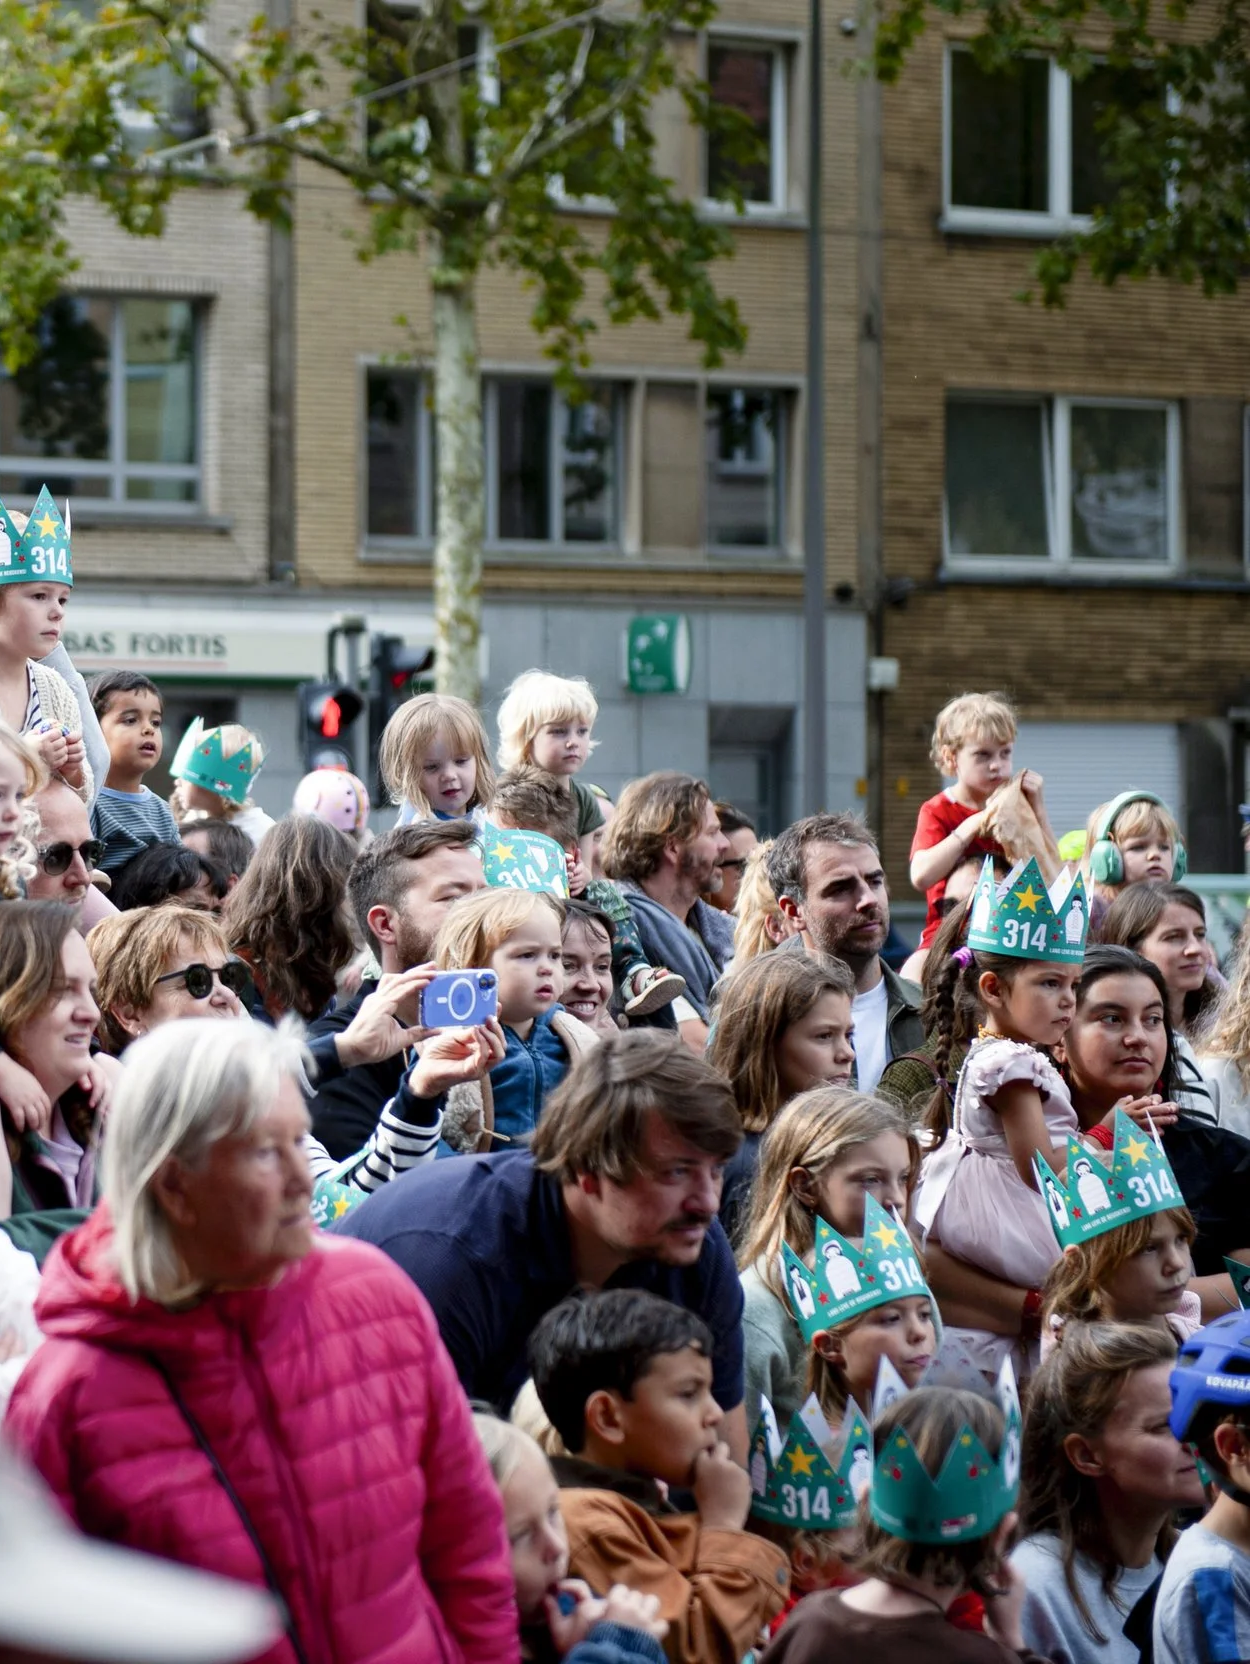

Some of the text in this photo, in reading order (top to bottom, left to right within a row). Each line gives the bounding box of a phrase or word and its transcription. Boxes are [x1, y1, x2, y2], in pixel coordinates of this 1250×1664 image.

[31, 546, 68, 576] 314
[130, 632, 227, 657] FORTIS
[497, 864, 542, 889] 314
[1002, 919, 1047, 952] 314
[1128, 1169, 1175, 1208] 314
[878, 1257, 924, 1291] 314
[782, 1483, 831, 1520] 314
